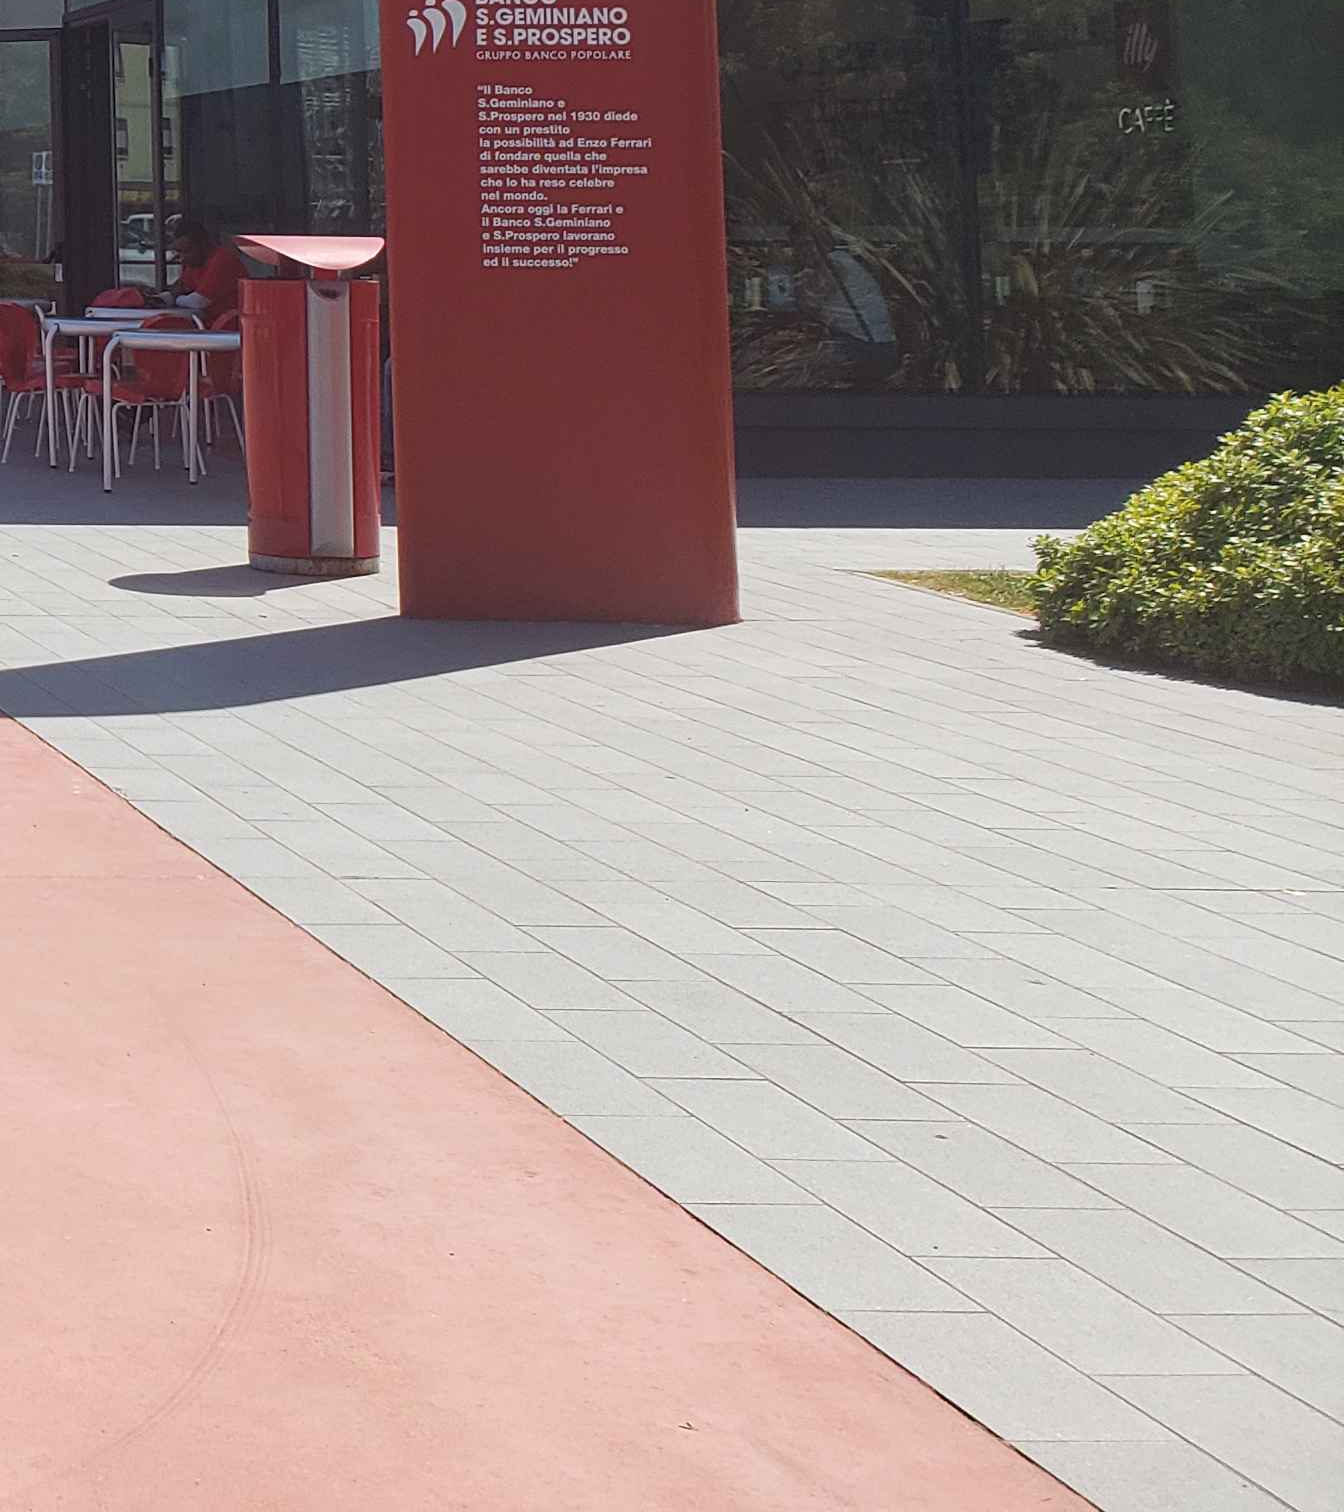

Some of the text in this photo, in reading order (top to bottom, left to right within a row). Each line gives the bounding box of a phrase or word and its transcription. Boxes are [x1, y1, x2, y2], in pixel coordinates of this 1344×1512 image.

[476, 7, 628, 26] S.GEMINIANO
[476, 27, 631, 46] E S.PROSPERO
[1123, 22, 1159, 72] illy
[475, 50, 632, 60] GRUPPO BANCO POPOLARE
[494, 84, 533, 95] Banco
[477, 97, 566, 108] S.Geminiano e
[478, 110, 638, 123] S.Prospero nel 1930 diede
[478, 124, 571, 137] con un prestito
[479, 137, 491, 148] la
[558, 137, 574, 148] ad
[577, 137, 608, 148] Enzo
[610, 137, 652, 148] Ferrari
[479, 150, 607, 163] di fondare quella che
[480, 164, 529, 174] sarebbe
[531, 164, 589, 174] diventata
[480, 177, 615, 188] che lo ha reso celebre
[481, 190, 548, 201] nel mondo.
[481, 203, 624, 216] Ancora oggi la Ferrari e
[481, 216, 611, 228] il Banco S.Geminiano
[481, 229, 616, 243] e S.Prospero lavorano
[482, 243, 629, 256] insieme per il progresso
[483, 256, 499, 267] ed
[501, 256, 510, 267] il
